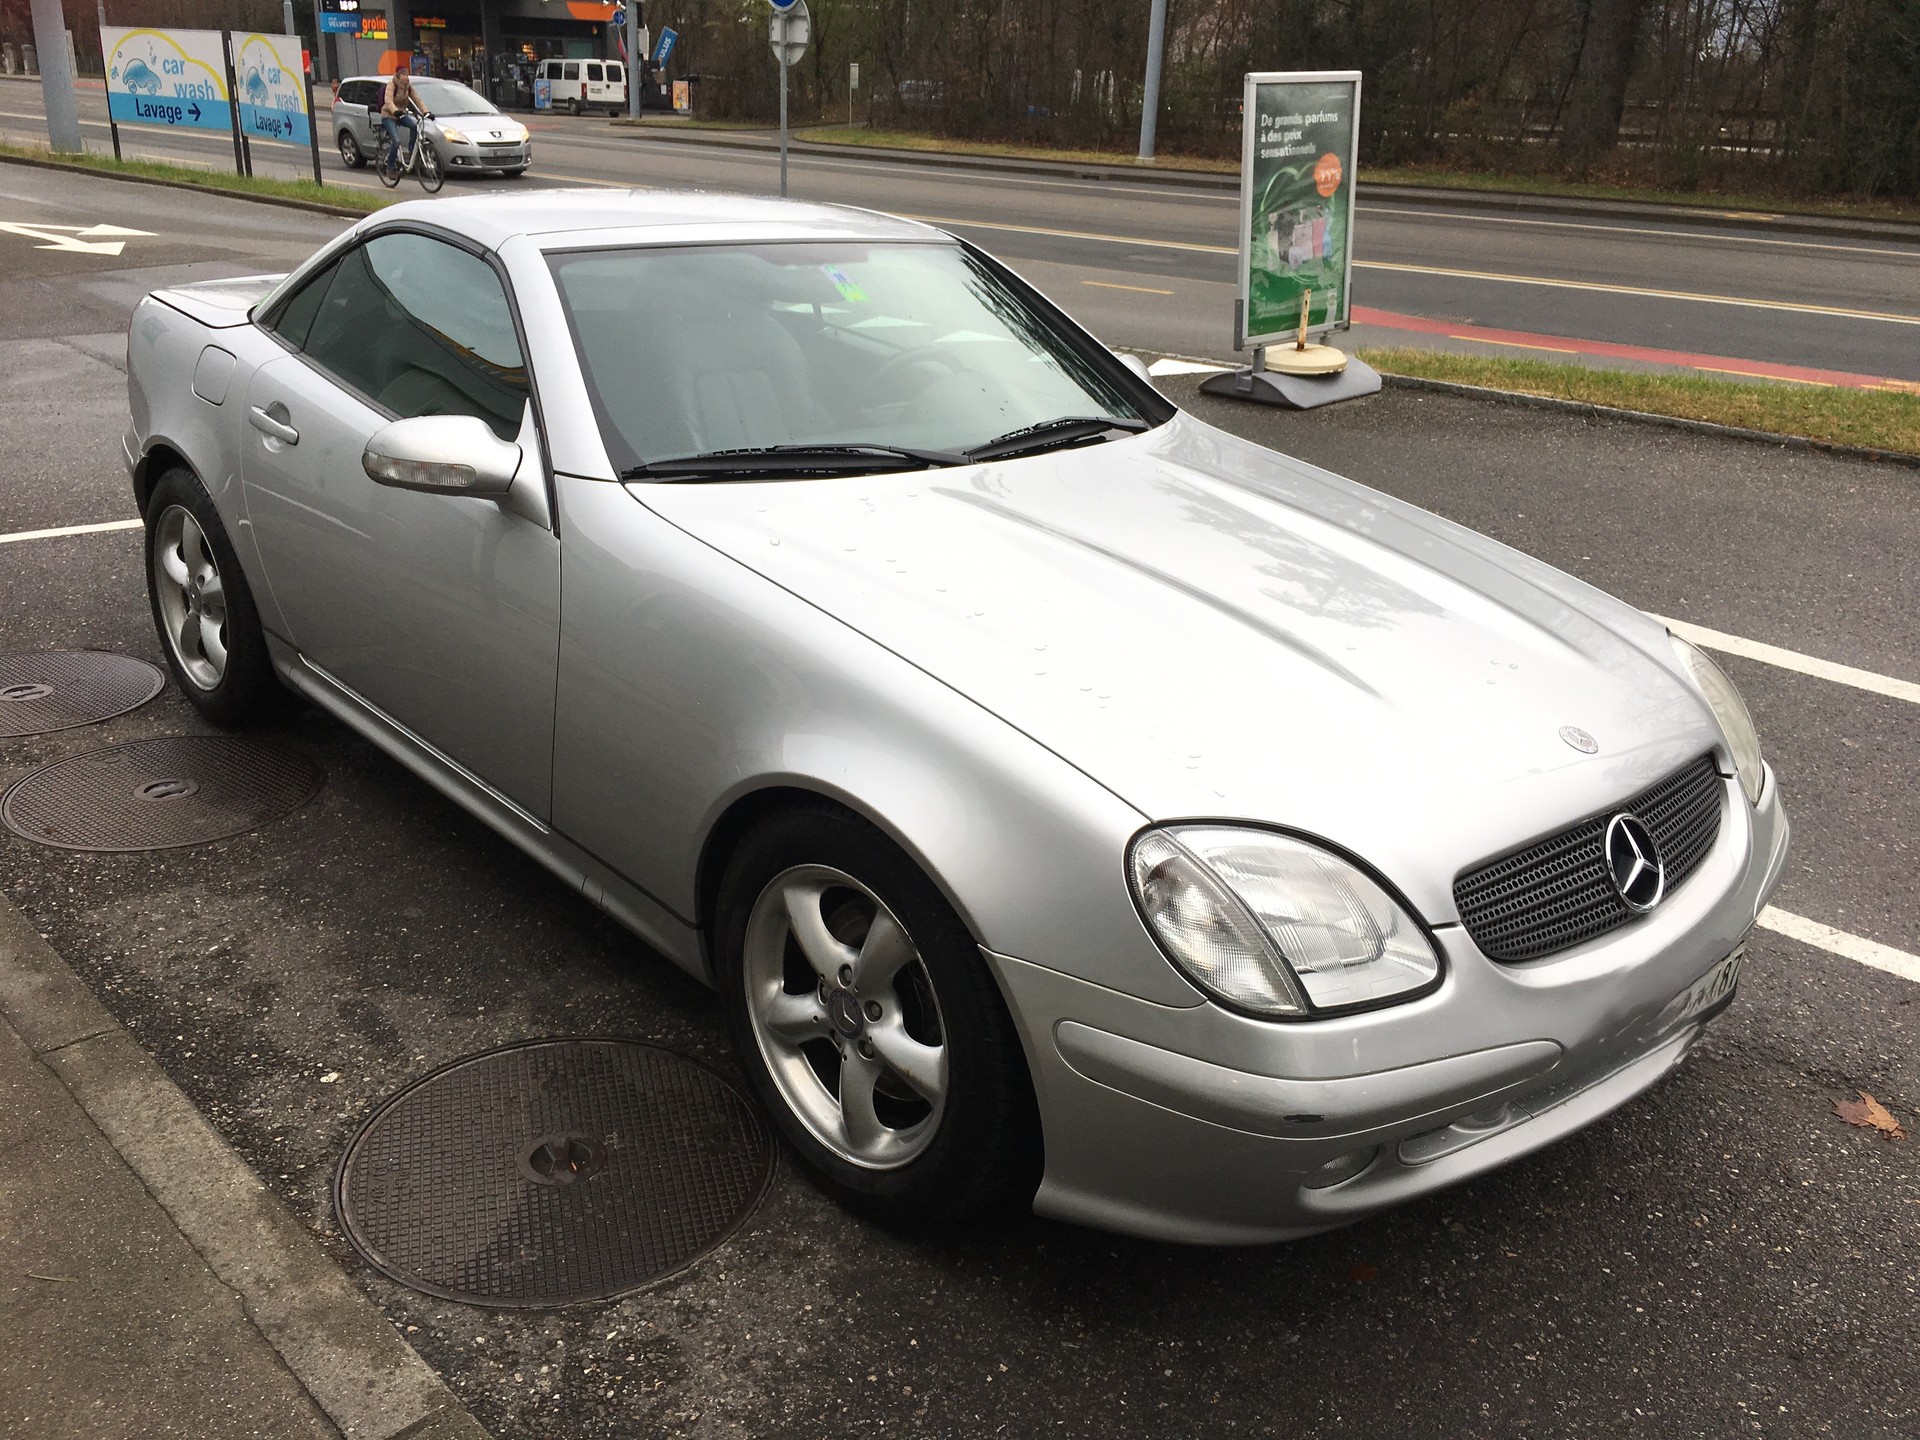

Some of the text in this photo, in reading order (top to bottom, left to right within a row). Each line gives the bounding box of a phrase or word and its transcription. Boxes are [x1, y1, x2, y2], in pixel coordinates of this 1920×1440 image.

[361, 14, 388, 35] grolin
[162, 56, 186, 76] car
[267, 66, 281, 84] car
[174, 79, 215, 101] wash
[136, 98, 183, 124] Lavage
[275, 90, 300, 113] wash
[254, 110, 282, 138] Lavage
[1261, 110, 1338, 129] De grands parfums
[1261, 128, 1302, 143] à des prix
